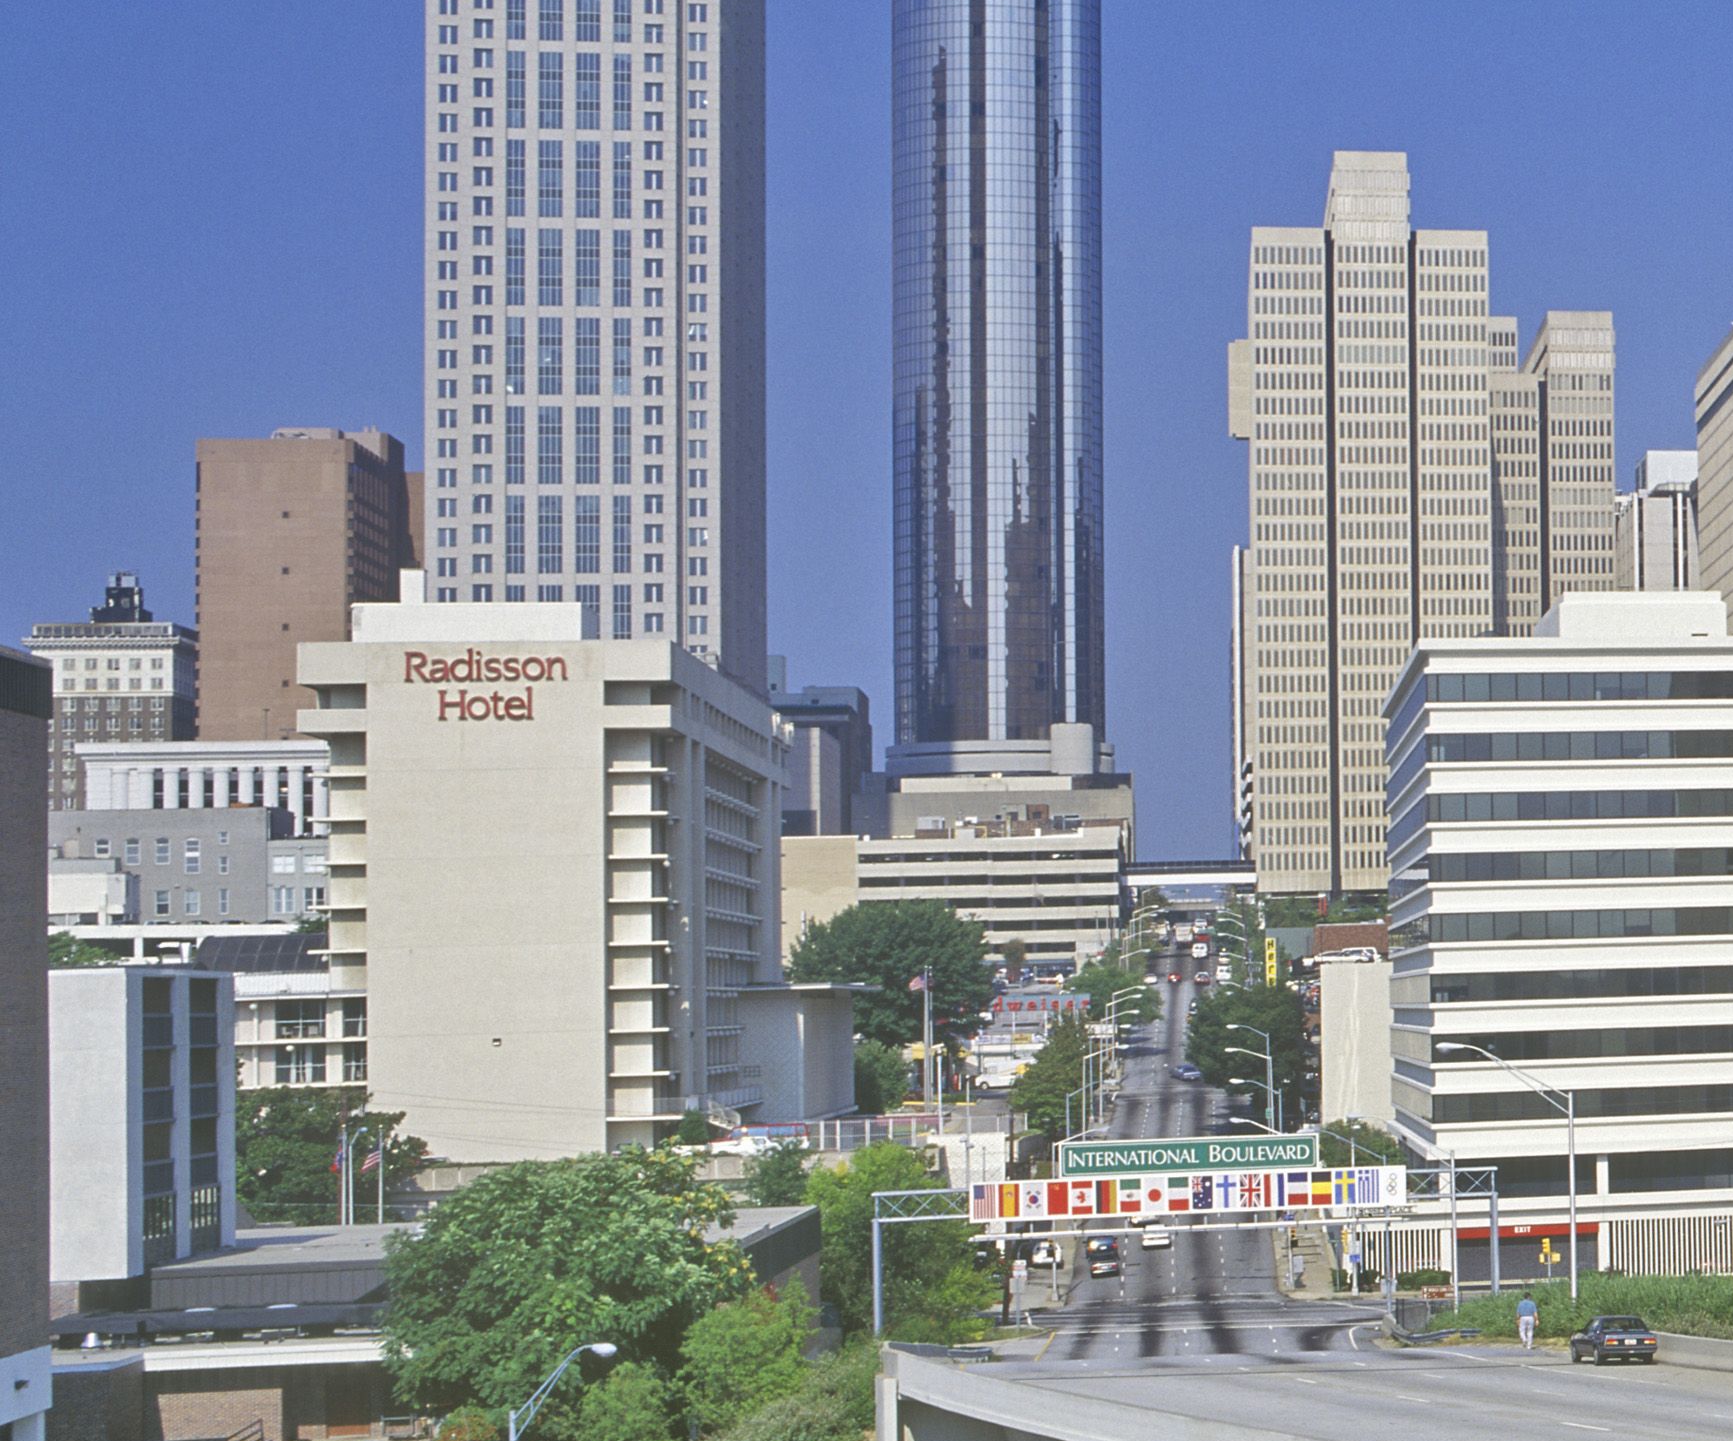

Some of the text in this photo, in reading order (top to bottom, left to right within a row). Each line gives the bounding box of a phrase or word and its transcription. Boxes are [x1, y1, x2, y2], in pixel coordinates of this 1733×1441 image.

[403, 646, 568, 684] Radisson
[437, 685, 535, 722] Hotel
[990, 994, 1090, 1013] dweiser
[1068, 1143, 1311, 1169] INTERNATIONAL BOULEVARD
[1514, 1226, 1531, 1234] EXIT
